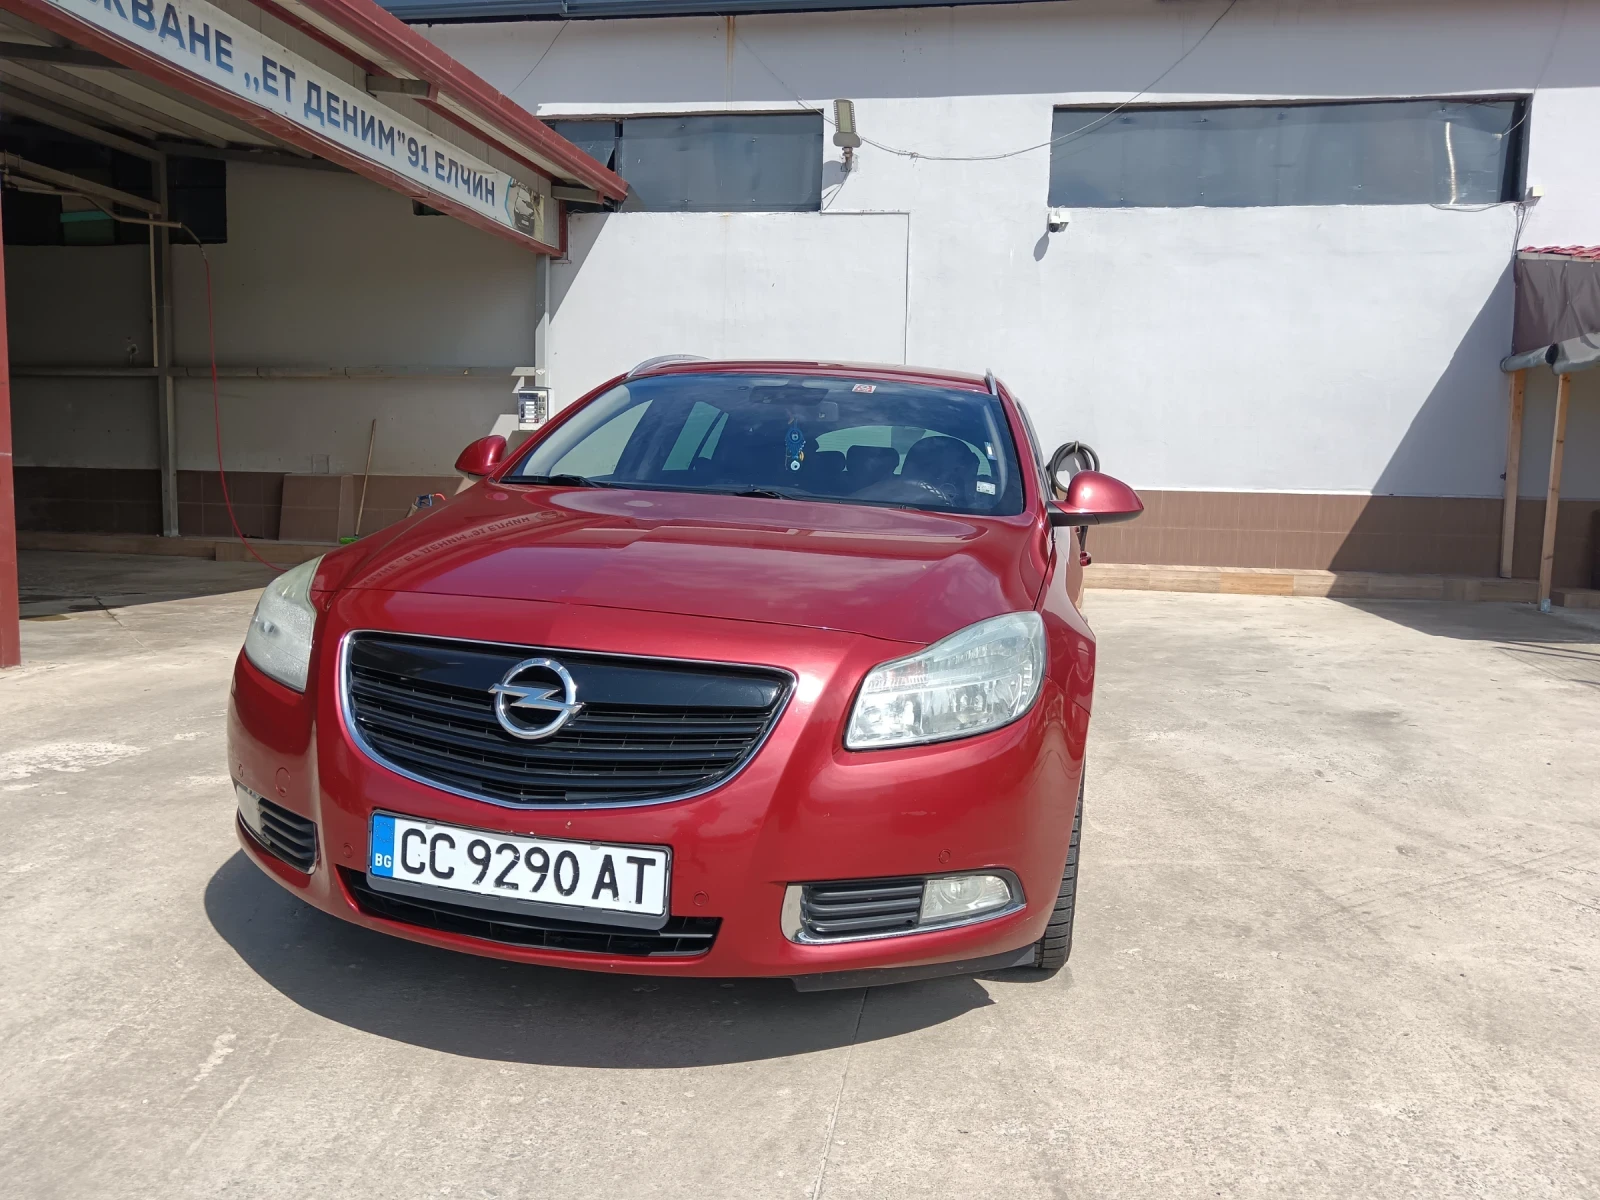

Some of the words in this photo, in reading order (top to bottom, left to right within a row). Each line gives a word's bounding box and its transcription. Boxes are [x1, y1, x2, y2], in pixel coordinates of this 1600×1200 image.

[434, 150, 496, 207] ЕЛЧИН
[374, 852, 392, 868] BG
[401, 828, 456, 880] CC
[466, 838, 580, 897] 9290
[591, 853, 657, 905] AT
